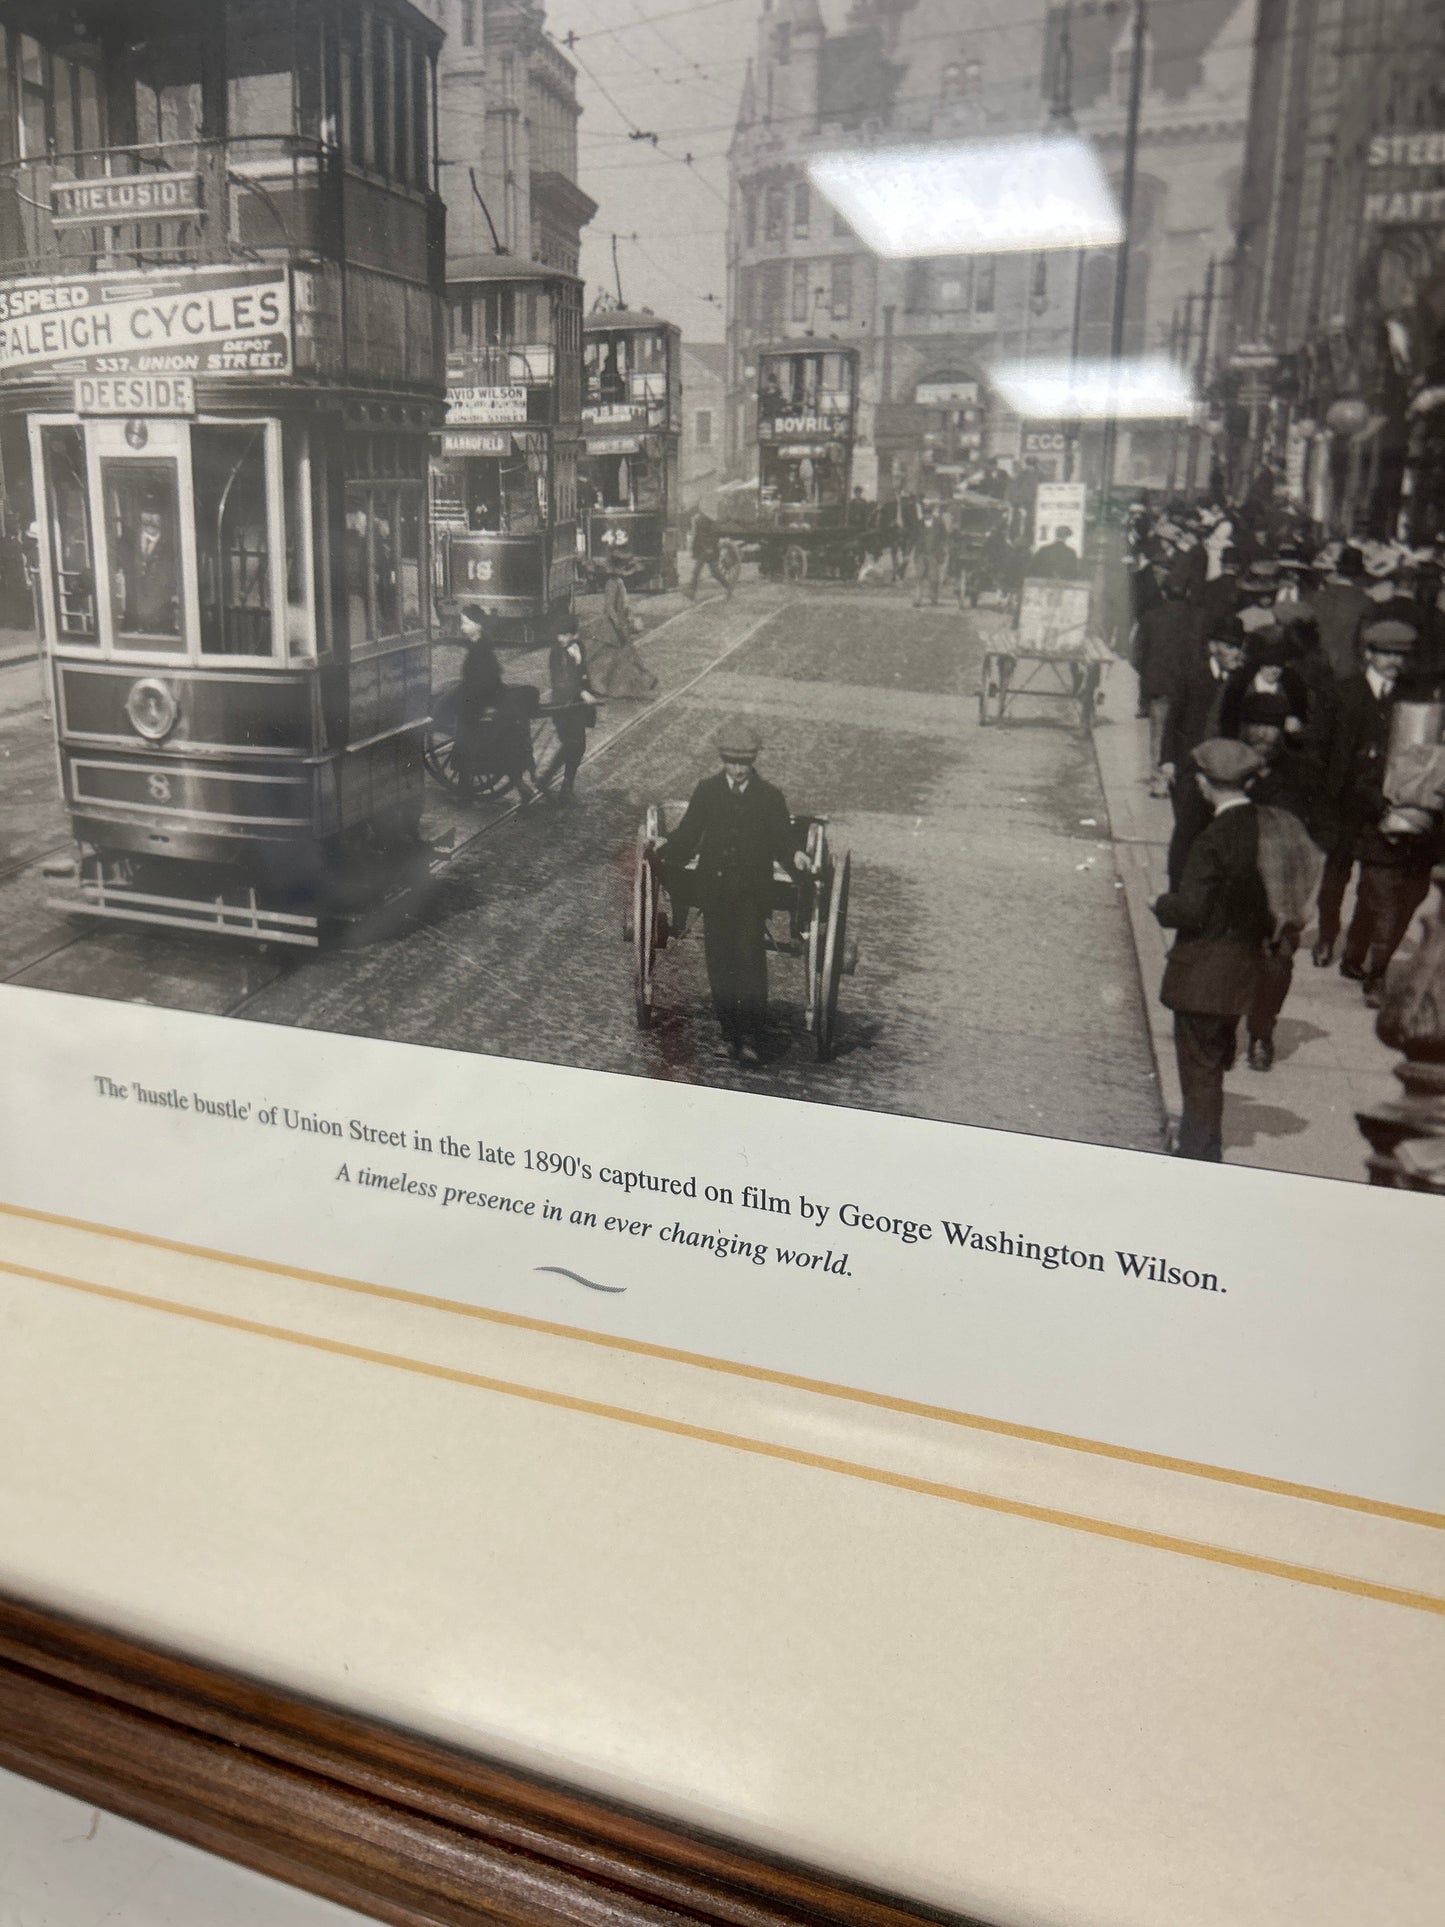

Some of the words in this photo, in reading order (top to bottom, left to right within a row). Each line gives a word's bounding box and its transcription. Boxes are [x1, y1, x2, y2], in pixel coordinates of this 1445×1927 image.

[130, 291, 279, 339] CYCLES
[222, 339, 272, 352] DEPOT
[138, 355, 199, 371] UNION
[81, 380, 186, 408] DEESIDE
[478, 388, 523, 399] WILSON
[775, 416, 832, 433] BOVRIL
[148, 774, 171, 800] 8
[93, 1074, 129, 1100] The
[131, 1082, 190, 1111] 'hustle
[192, 1092, 252, 1121] bustle'
[257, 1105, 280, 1126] of
[282, 1107, 344, 1138] Union
[349, 1119, 408, 1149] Street
[412, 1129, 434, 1153] in
[438, 1135, 472, 1160] the
[477, 1140, 516, 1167] late
[523, 1148, 593, 1180] 1890's
[598, 1167, 698, 1199] captured
[704, 1185, 735, 1206] on
[740, 1185, 792, 1216] film
[798, 1194, 831, 1228] by
[838, 1203, 933, 1245] George
[940, 1219, 1106, 1273] Washington
[1114, 1250, 1228, 1294] Wilson.
[334, 1162, 352, 1183] A
[357, 1166, 438, 1199] timeless
[440, 1186, 536, 1216] presence
[542, 1198, 563, 1222] in
[569, 1209, 598, 1228] an
[603, 1216, 653, 1237] ever
[658, 1221, 769, 1266] changing
[775, 1247, 852, 1277] world.
